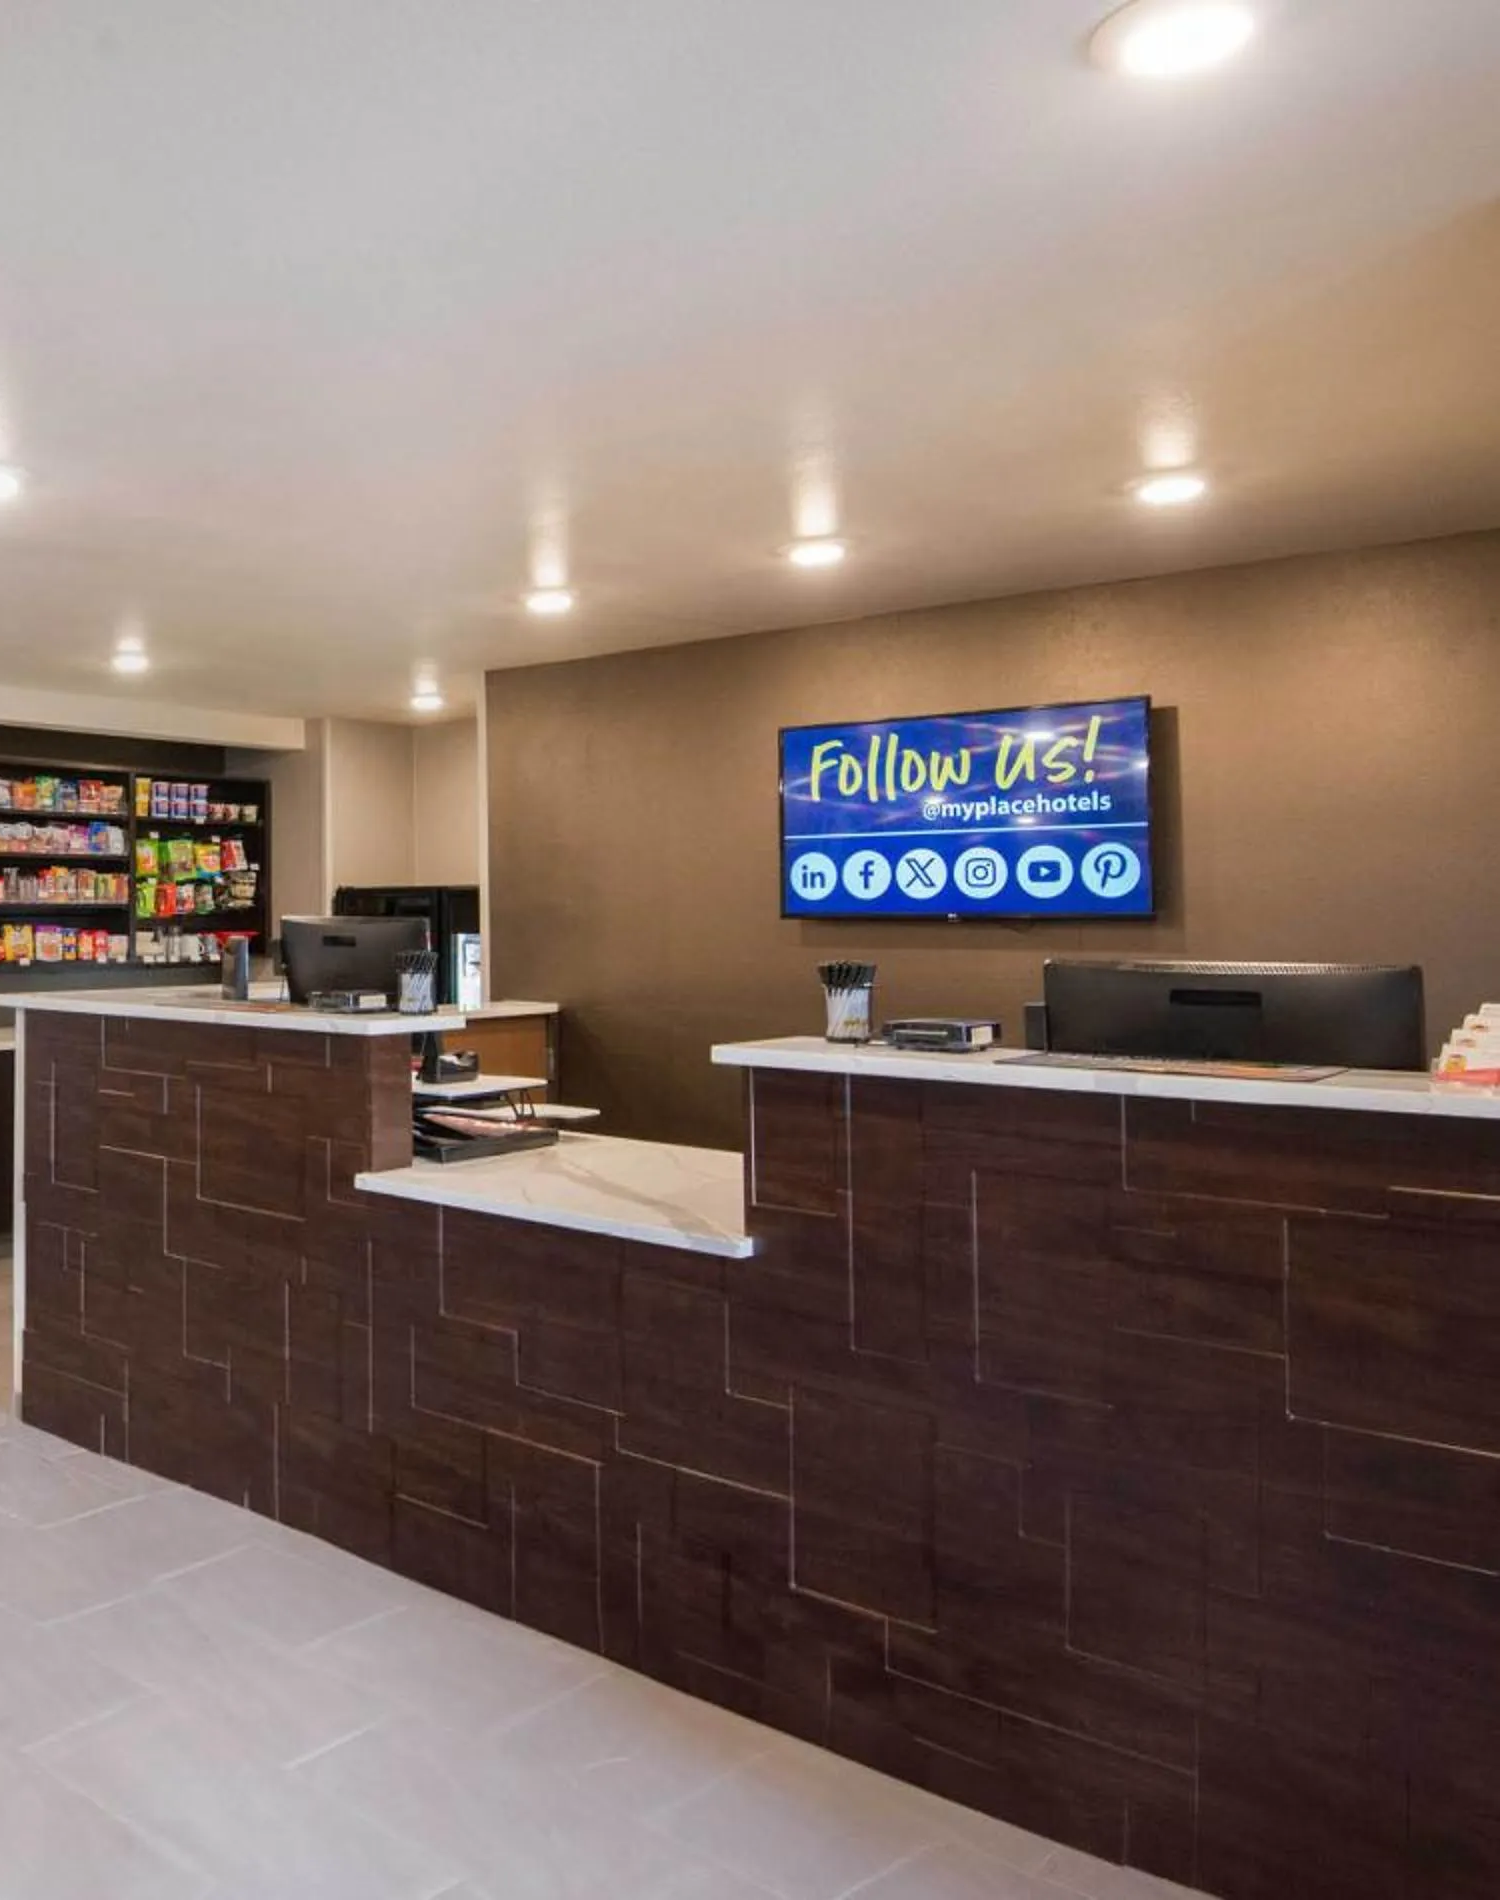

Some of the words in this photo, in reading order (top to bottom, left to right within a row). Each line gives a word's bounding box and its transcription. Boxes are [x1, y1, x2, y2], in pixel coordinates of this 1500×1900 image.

[810, 732, 971, 802] Follow
[923, 790, 1112, 821] @myplacehotels
[801, 865, 826, 889] in
[859, 860, 876, 889] f
